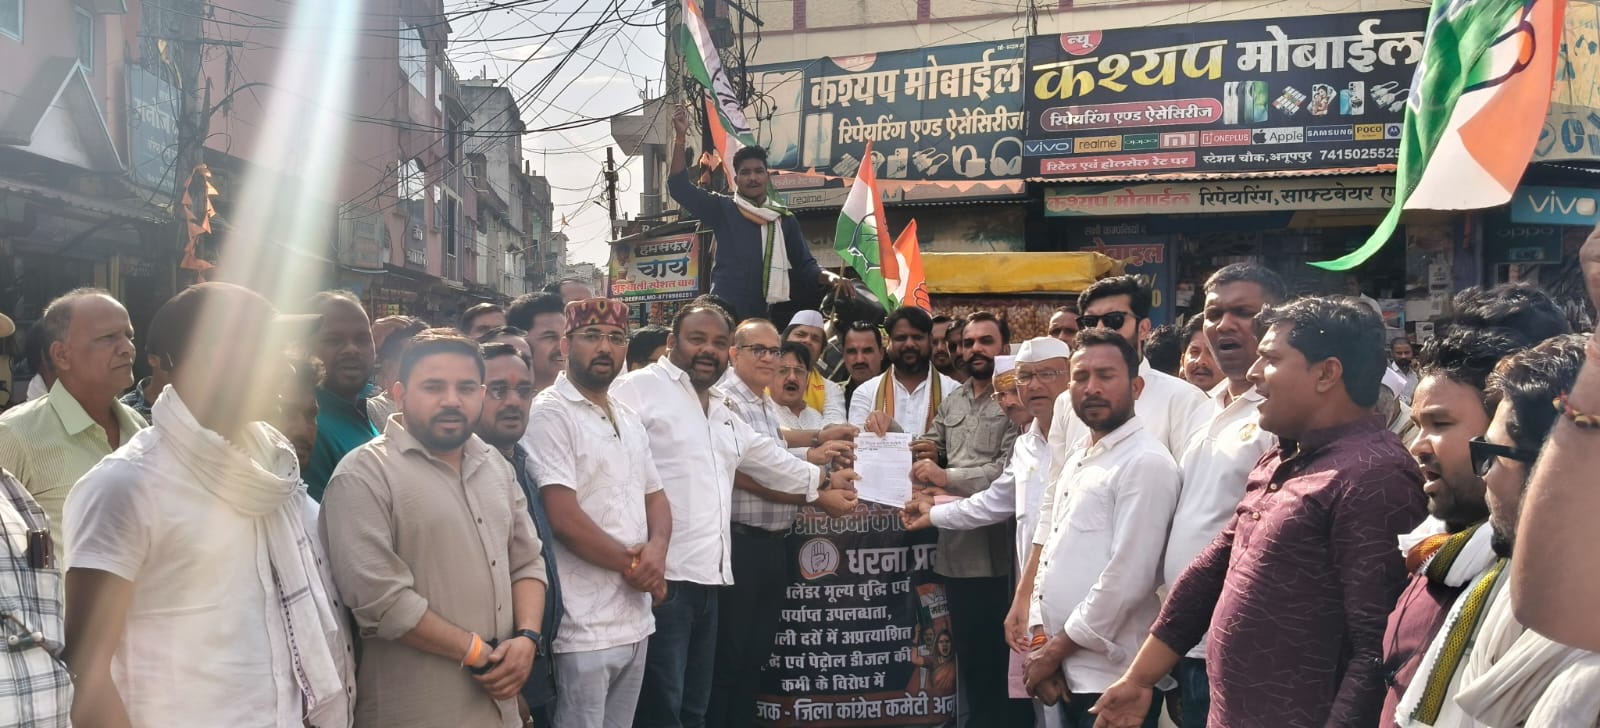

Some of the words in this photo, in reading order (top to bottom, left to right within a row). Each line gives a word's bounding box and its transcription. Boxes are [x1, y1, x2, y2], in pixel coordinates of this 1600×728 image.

[1032, 39, 1228, 100] कश्यप
[1236, 19, 1424, 73] मोबाईल
[811, 69, 900, 109] कश्यप
[904, 49, 1023, 101] मोबाईल
[1050, 108, 1110, 127] रिपेयरिंग
[1113, 112, 1141, 124] एण्ड
[1145, 103, 1212, 123] ऐसेसिरीज
[838, 114, 906, 144] रिपेयरिंग
[910, 117, 942, 142] एण्ड
[1213, 133, 1249, 143] ONEPLUS
[1270, 131, 1303, 144] Apple
[1307, 128, 1353, 137] SAMSUNG
[1356, 126, 1382, 134] POCO
[1025, 141, 1070, 153] vivo
[1079, 138, 1117, 149] realme
[1047, 158, 1076, 171] रिटेल
[1080, 158, 1098, 171] एवं
[1152, 154, 1168, 167] रेट
[1170, 156, 1188, 166] पर
[1202, 151, 1235, 164] स्टेशन
[1528, 190, 1597, 216] vivo
[637, 256, 690, 278] चाय
[846, 546, 909, 574] धरना
[824, 584, 855, 603] मूल्य
[857, 579, 888, 601] वृद्धि
[891, 577, 911, 594] एवं
[800, 628, 823, 646] दरों
[826, 627, 838, 645] में
[842, 624, 912, 645] अप्रत्याशित
[784, 652, 806, 669] एवं
[809, 651, 846, 672] पेट्रोल
[849, 650, 890, 667] डीजल
[894, 645, 912, 663] की
[781, 675, 810, 692] कमी
[814, 675, 829, 691] के
[833, 673, 870, 691] विरोध
[873, 671, 886, 688] में
[793, 698, 834, 720] जिला
[836, 696, 882, 720] कांग्रेस
[885, 691, 928, 717] कमेटी
